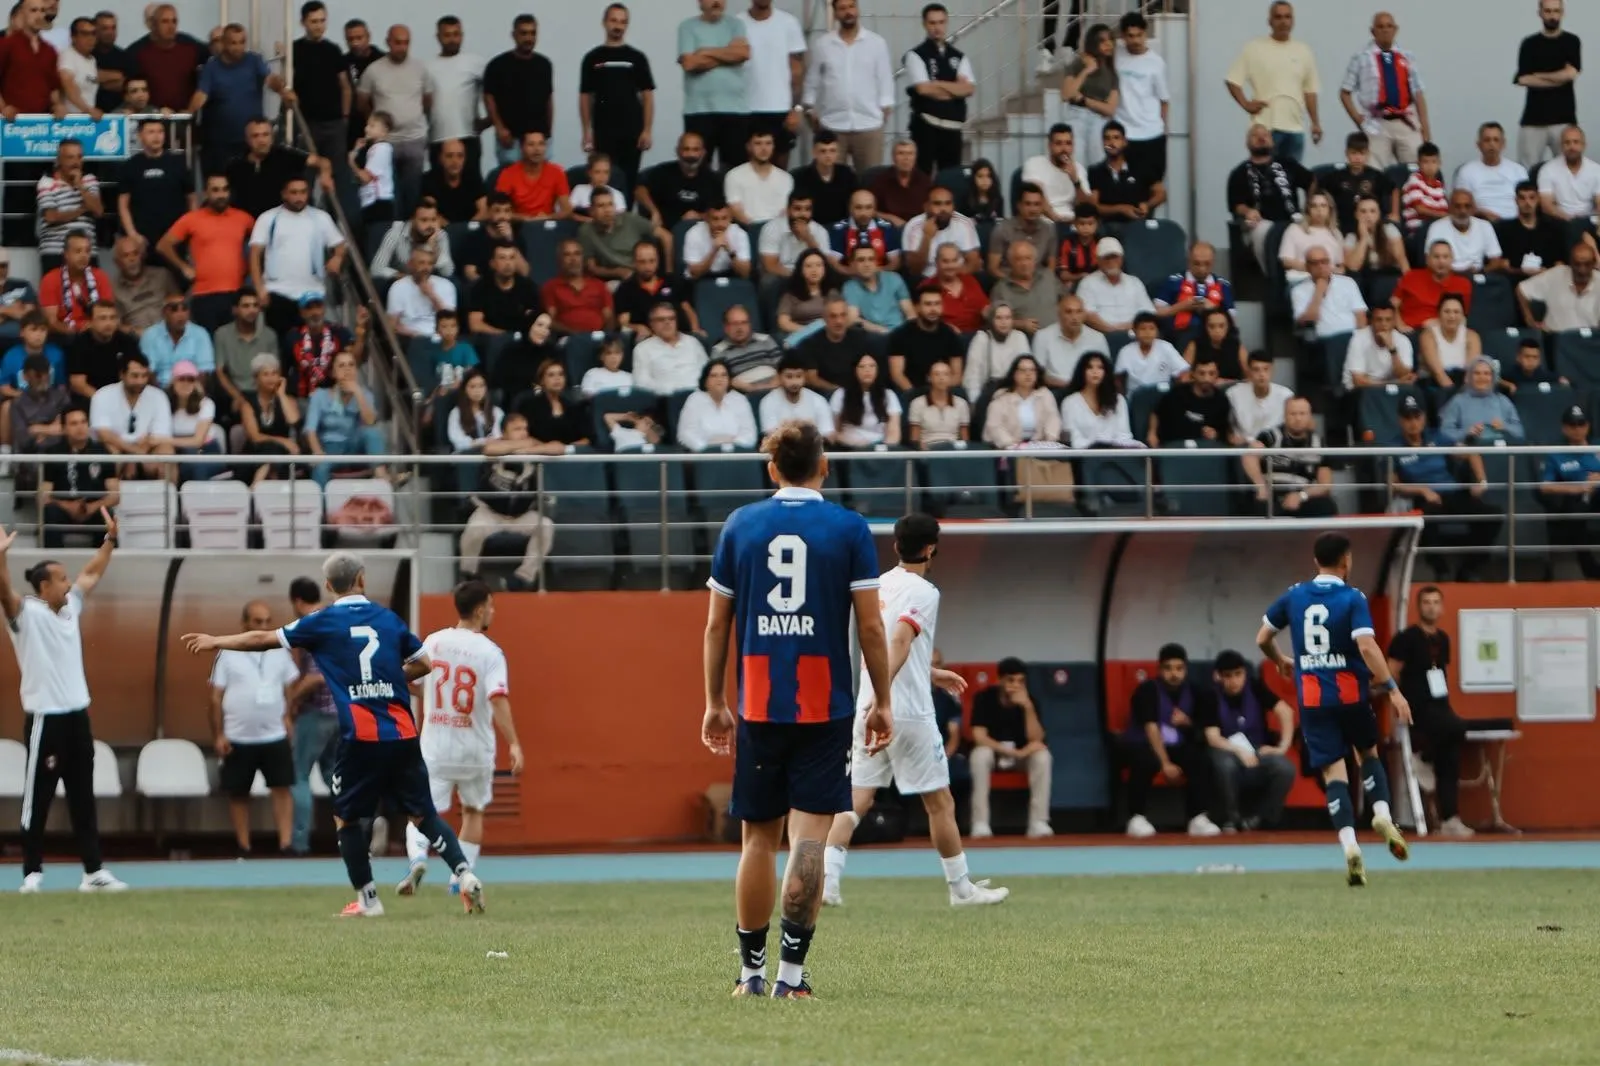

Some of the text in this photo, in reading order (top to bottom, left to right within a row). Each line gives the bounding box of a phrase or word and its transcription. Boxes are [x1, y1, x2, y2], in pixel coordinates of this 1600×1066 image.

[4, 122, 96, 139] Engelli Seyirci
[767, 534, 807, 613] 9
[757, 615, 815, 636] BAYAR
[1303, 603, 1330, 656] 6
[349, 625, 380, 681] 7
[431, 659, 477, 715] 78
